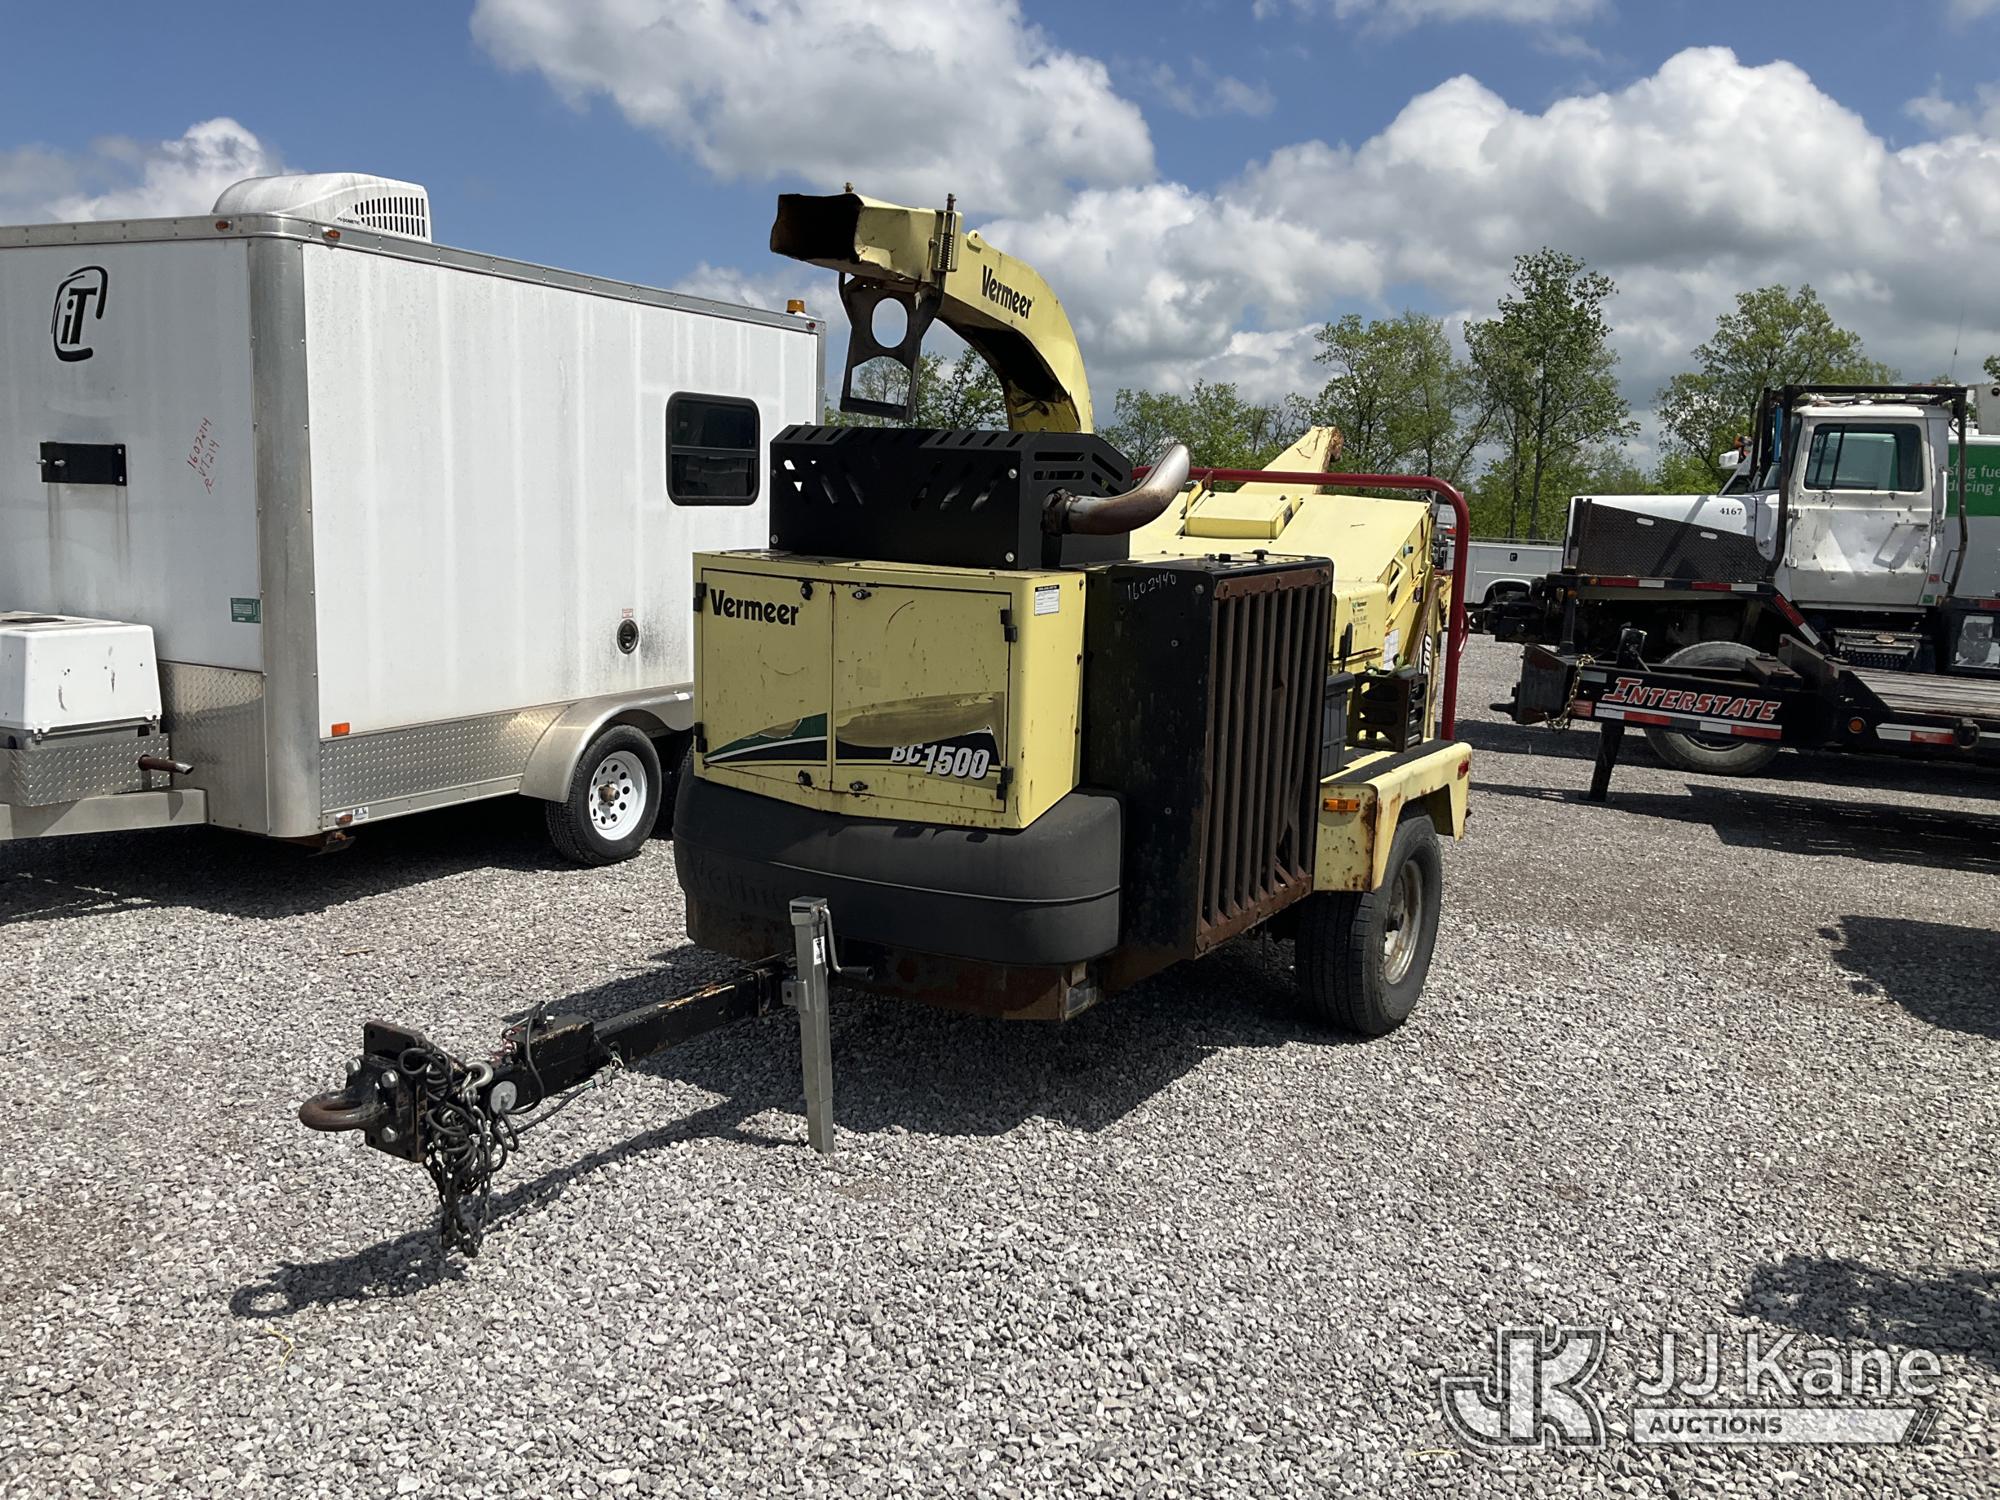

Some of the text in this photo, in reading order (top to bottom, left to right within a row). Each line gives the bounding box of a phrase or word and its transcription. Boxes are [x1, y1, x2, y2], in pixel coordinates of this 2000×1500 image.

[982, 264, 1032, 319] Vermeer
[1720, 507, 1743, 515] 4167
[1127, 571, 1177, 600] 1602440
[710, 588, 799, 626] Vermeer
[1602, 677, 1782, 721] INTERSTATE
[890, 743, 991, 779] BC1500
